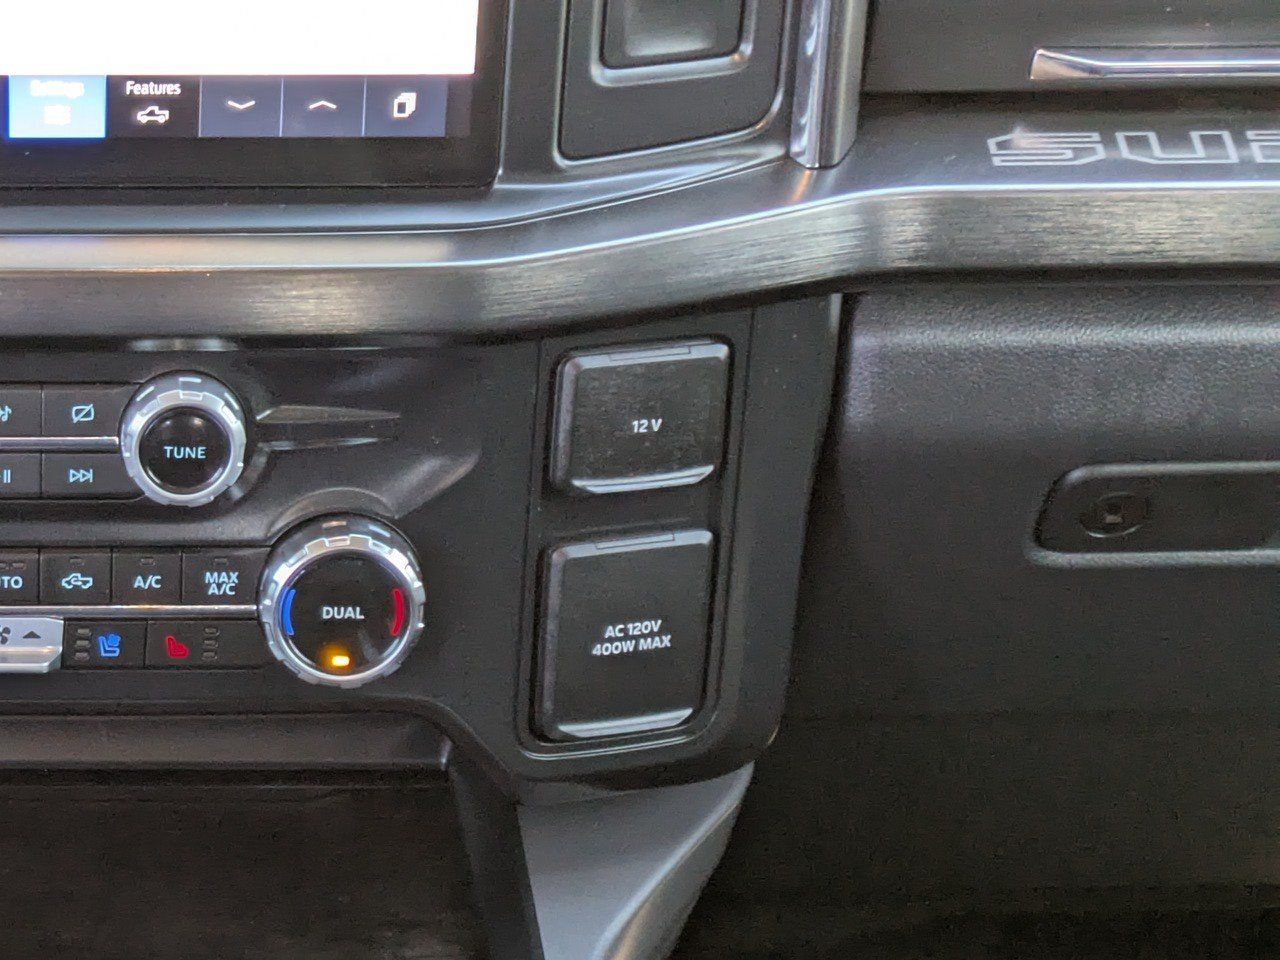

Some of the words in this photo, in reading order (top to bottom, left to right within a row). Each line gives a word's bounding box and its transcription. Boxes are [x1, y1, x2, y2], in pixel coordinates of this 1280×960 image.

[125, 80, 181, 95] Features
[986, 131, 1280, 166] SU
[164, 445, 206, 459] TUNE
[133, 575, 162, 590] A/C
[204, 571, 239, 584] MAX
[207, 583, 236, 596] A/C
[322, 606, 365, 620] DUAL
[604, 624, 625, 638] AC
[627, 619, 662, 636] 120V
[592, 640, 636, 656] 400W
[639, 634, 671, 651] MAX
